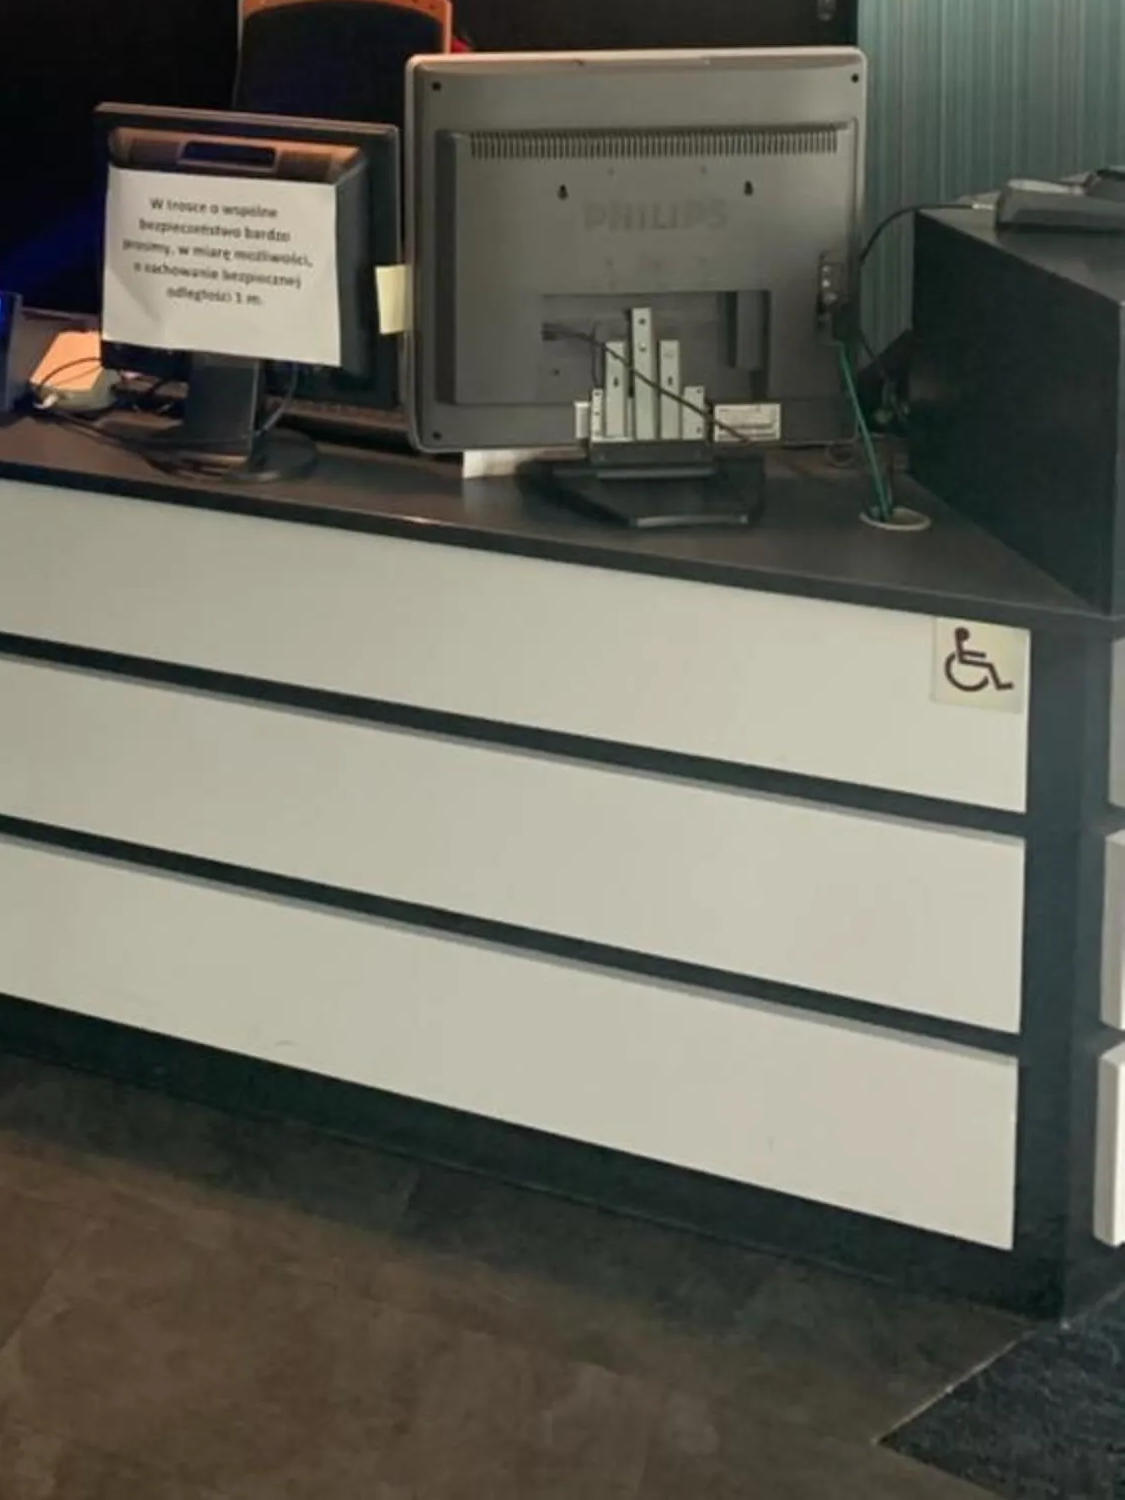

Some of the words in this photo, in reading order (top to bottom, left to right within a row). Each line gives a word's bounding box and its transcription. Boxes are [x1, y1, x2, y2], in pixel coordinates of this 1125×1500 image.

[149, 197, 164, 211] W
[166, 199, 207, 213] trosce
[209, 203, 219, 214] o
[583, 199, 728, 233] PHILIPS
[243, 225, 291, 242] bardzo
[177, 245, 190, 256] w
[144, 261, 219, 280] zachowanie
[221, 268, 302, 290] bezpiecznej
